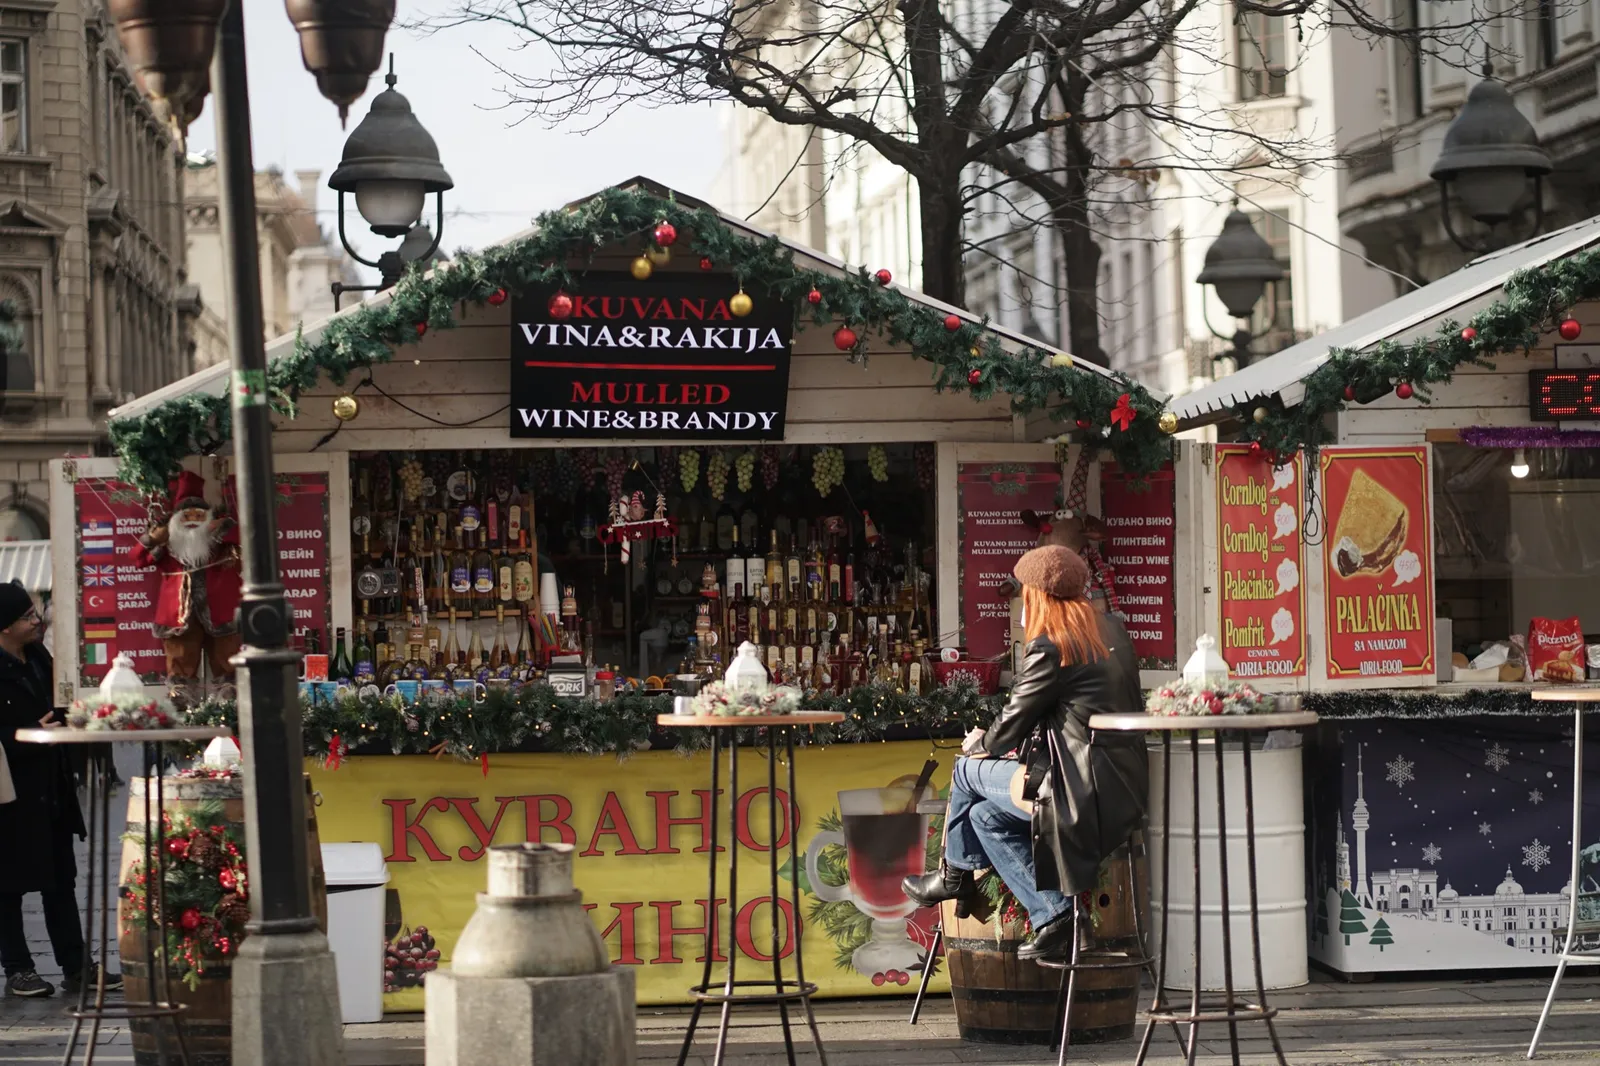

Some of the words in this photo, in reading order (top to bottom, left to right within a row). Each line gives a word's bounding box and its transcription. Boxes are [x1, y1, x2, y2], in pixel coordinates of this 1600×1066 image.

[572, 296, 734, 320] KUVANA
[518, 323, 785, 353] VINA&RAKIJA
[571, 381, 731, 405] MULLED
[517, 408, 779, 430] WINE&BRANDY
[1223, 475, 1267, 516] CornDog
[1106, 517, 1143, 526] КУВАНО
[1146, 516, 1172, 525] ВИНО
[286, 529, 322, 539] ВИНО
[1112, 534, 1166, 546] ГЛИНТВЕЙН
[1223, 523, 1268, 563] CornDog
[1108, 556, 1144, 565] MULLED
[1146, 556, 1170, 565] WINE
[117, 574, 145, 582] WINE
[286, 569, 321, 579] WINE
[1115, 575, 1135, 584] ICAK
[117, 592, 148, 600] SICAK
[283, 588, 317, 598] ARAP
[1336, 583, 1421, 633] PALAČINKA
[1132, 612, 1161, 623] BRULÈ
[1225, 617, 1265, 648] Pomfrit
[1537, 633, 1578, 646] plazma
[1354, 641, 1367, 652] SA
[1368, 639, 1407, 651] NAMAZOM
[1235, 661, 1264, 676] ADRIA
[1266, 660, 1293, 674] FOOD
[1359, 661, 1380, 675] ADRIA
[1381, 660, 1403, 673] FOOD
[382, 786, 800, 862] КУВАНО
[583, 896, 803, 966] ИНО
